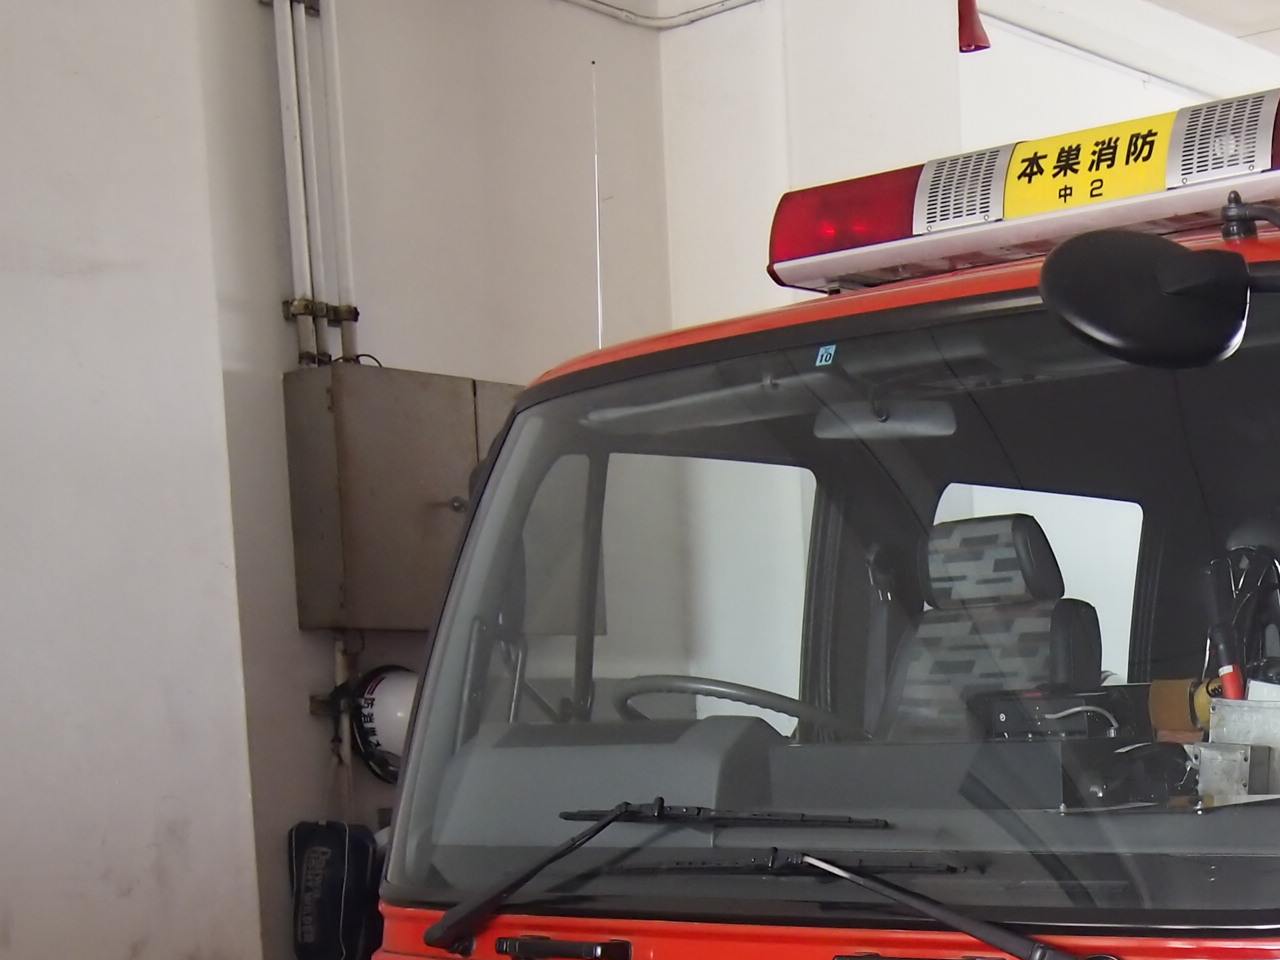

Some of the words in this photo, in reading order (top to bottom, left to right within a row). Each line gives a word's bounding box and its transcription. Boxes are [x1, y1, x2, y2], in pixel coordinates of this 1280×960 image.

[1017, 129, 1158, 184] 本巣消防
[819, 352, 832, 363] 10
